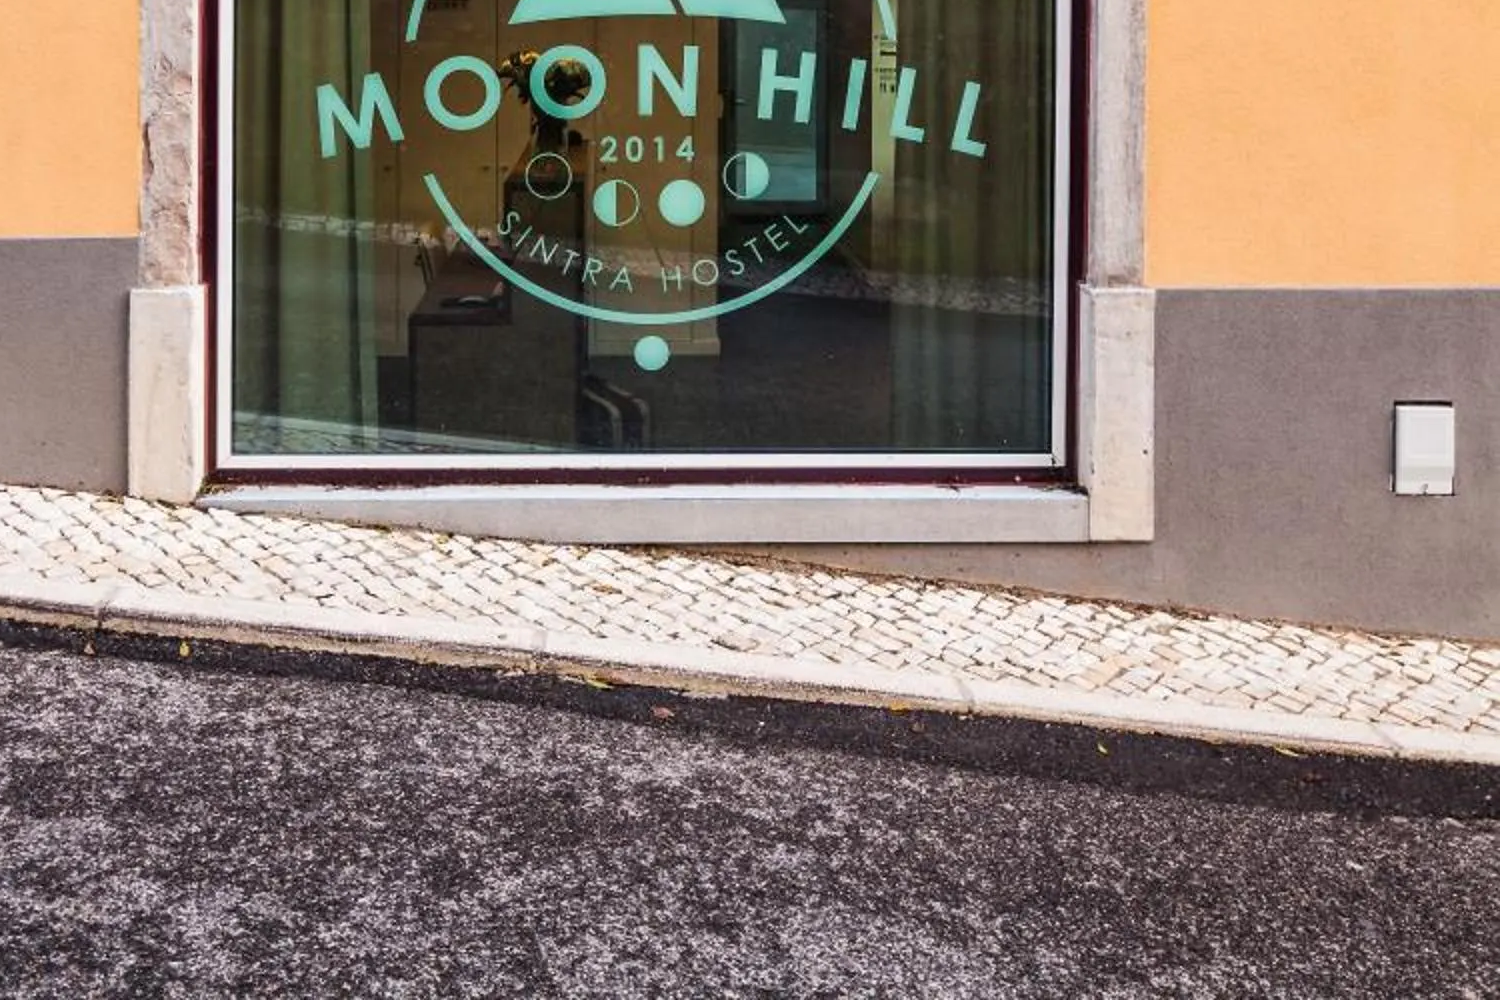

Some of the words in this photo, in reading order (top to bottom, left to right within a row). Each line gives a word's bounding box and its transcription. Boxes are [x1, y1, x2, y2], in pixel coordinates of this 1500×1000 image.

[316, 44, 699, 157] MOON
[757, 48, 987, 157] HILL
[599, 134, 696, 163] 2014
[497, 210, 633, 293] SINTRA
[661, 214, 808, 293] HOSTEL
